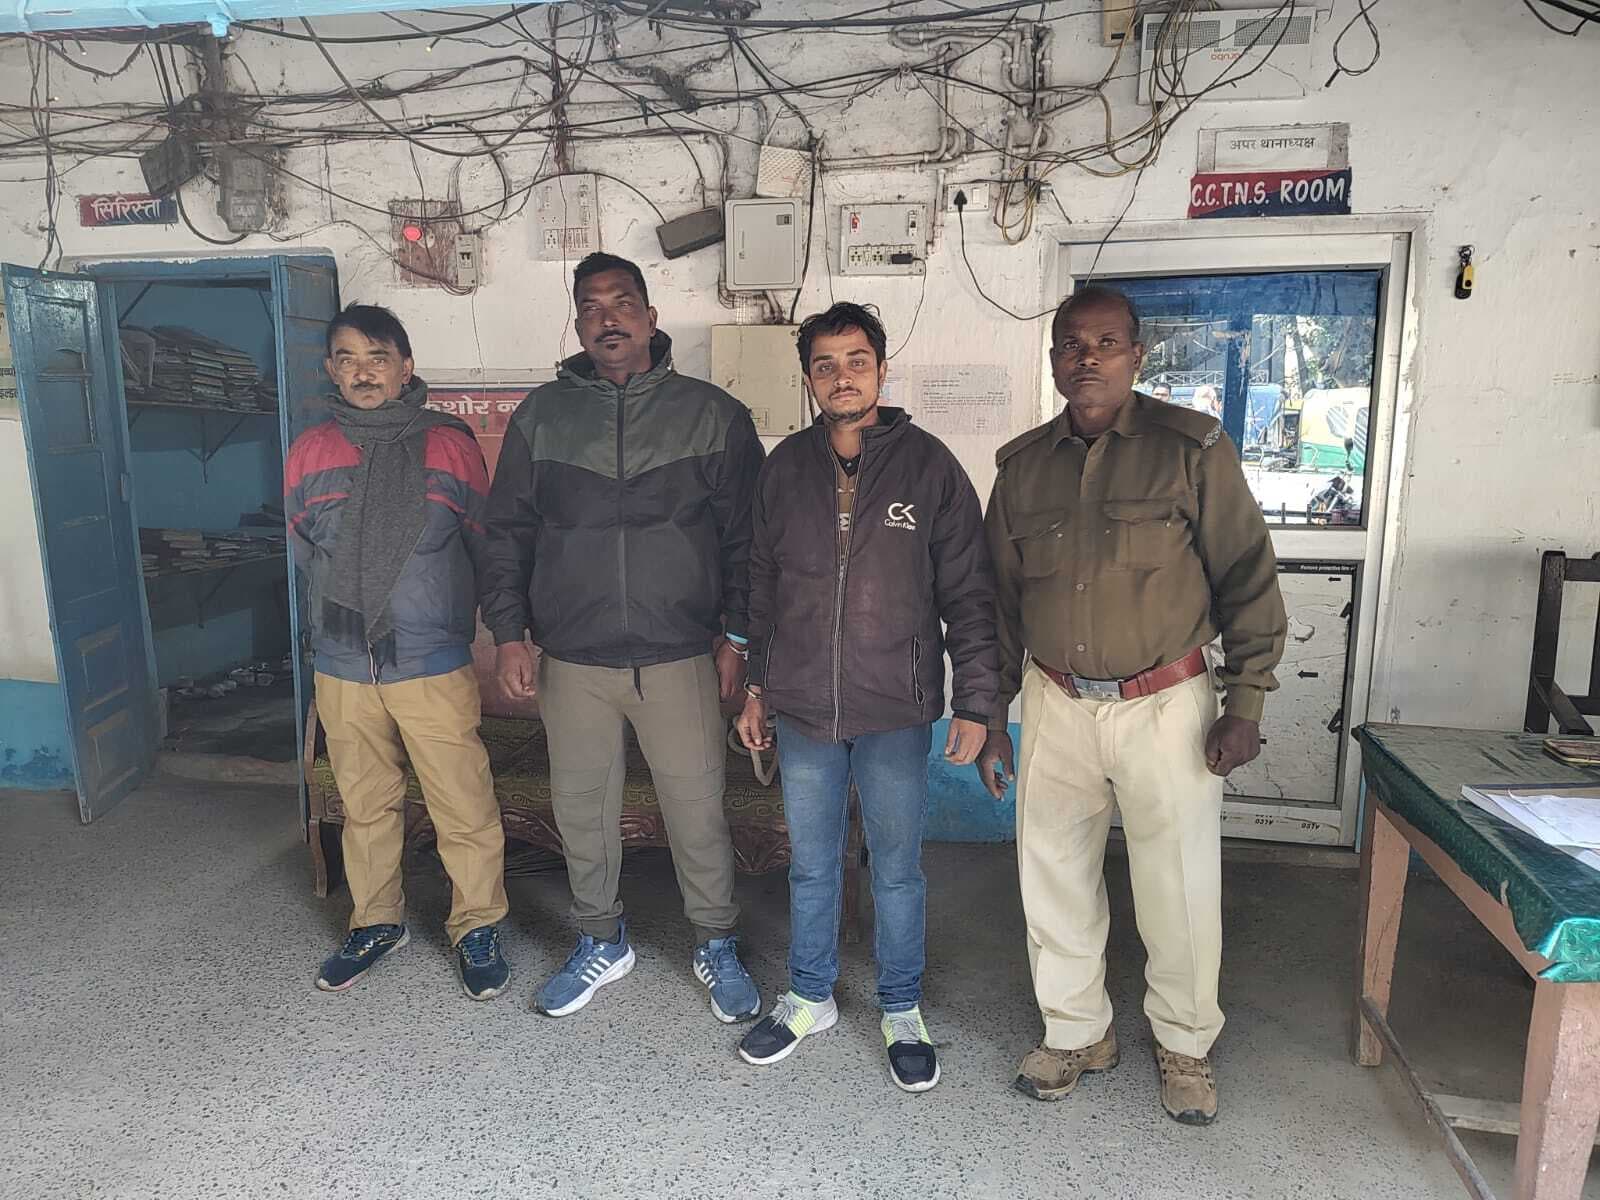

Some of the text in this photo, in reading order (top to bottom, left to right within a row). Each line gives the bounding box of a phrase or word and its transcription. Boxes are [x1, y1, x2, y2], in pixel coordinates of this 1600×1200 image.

[1230, 137, 1316, 150] अपर थानाध्यक्ष
[1191, 177, 1346, 207] C.C.T.N.S. ROOM
[90, 197, 162, 223] सिरिस्ता
[888, 503, 915, 523] CK
